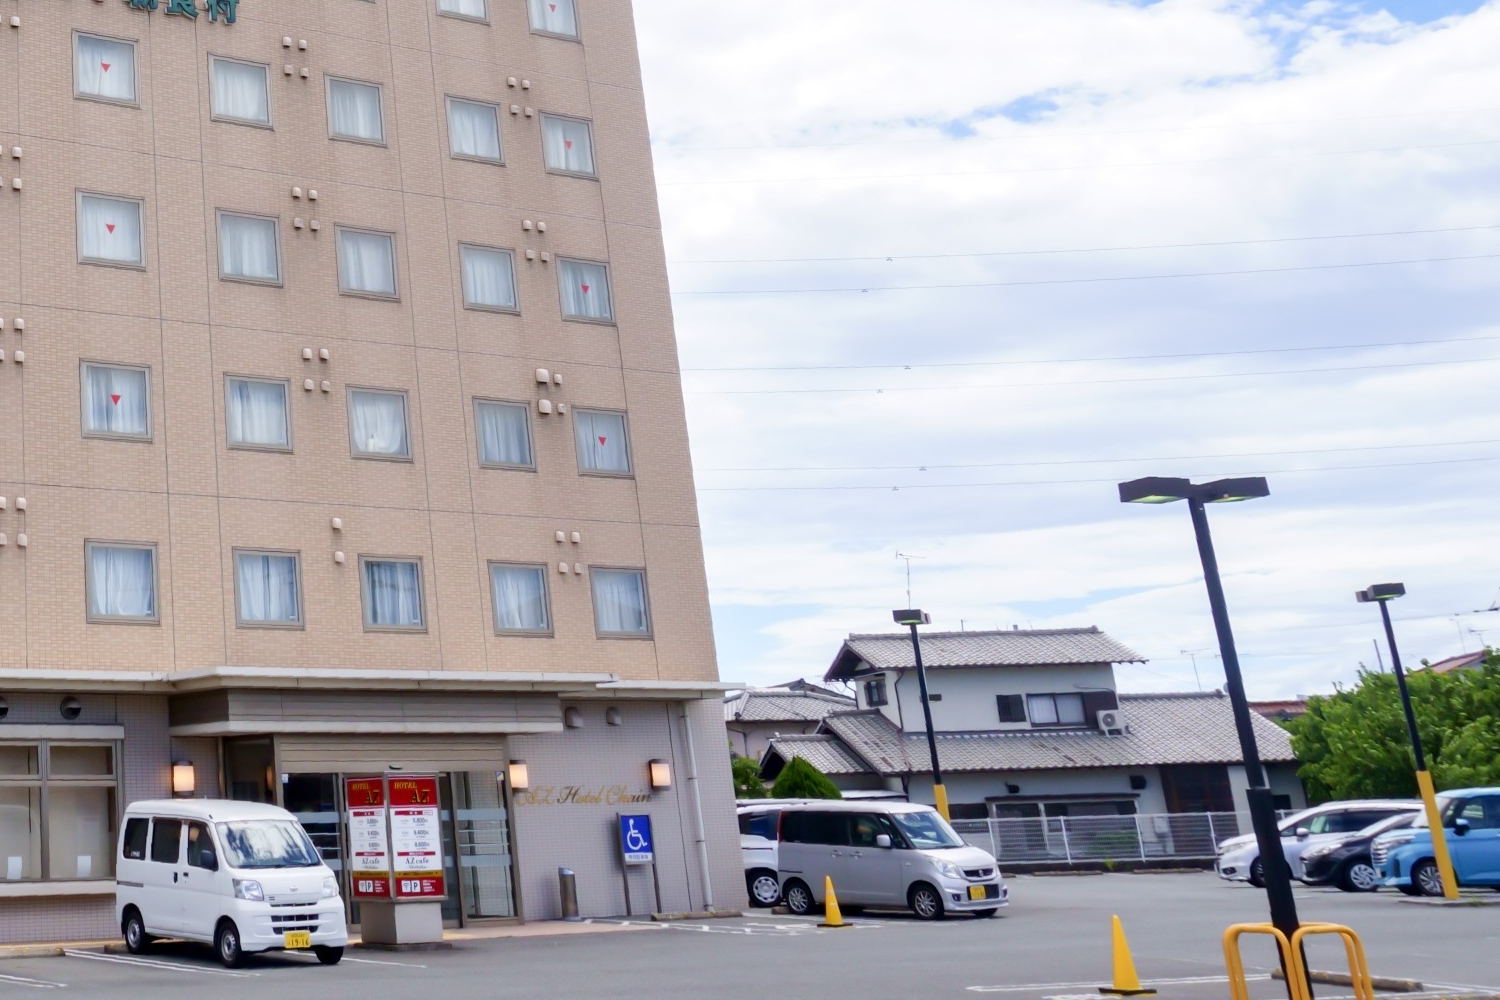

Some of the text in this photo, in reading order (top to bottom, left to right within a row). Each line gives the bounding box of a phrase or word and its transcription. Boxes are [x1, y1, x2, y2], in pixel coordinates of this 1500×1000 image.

[394, 782, 417, 790] HOTEL
[410, 789, 431, 804] AZ
[556, 785, 604, 805] Hotel
[605, 784, 652, 806] Chain
